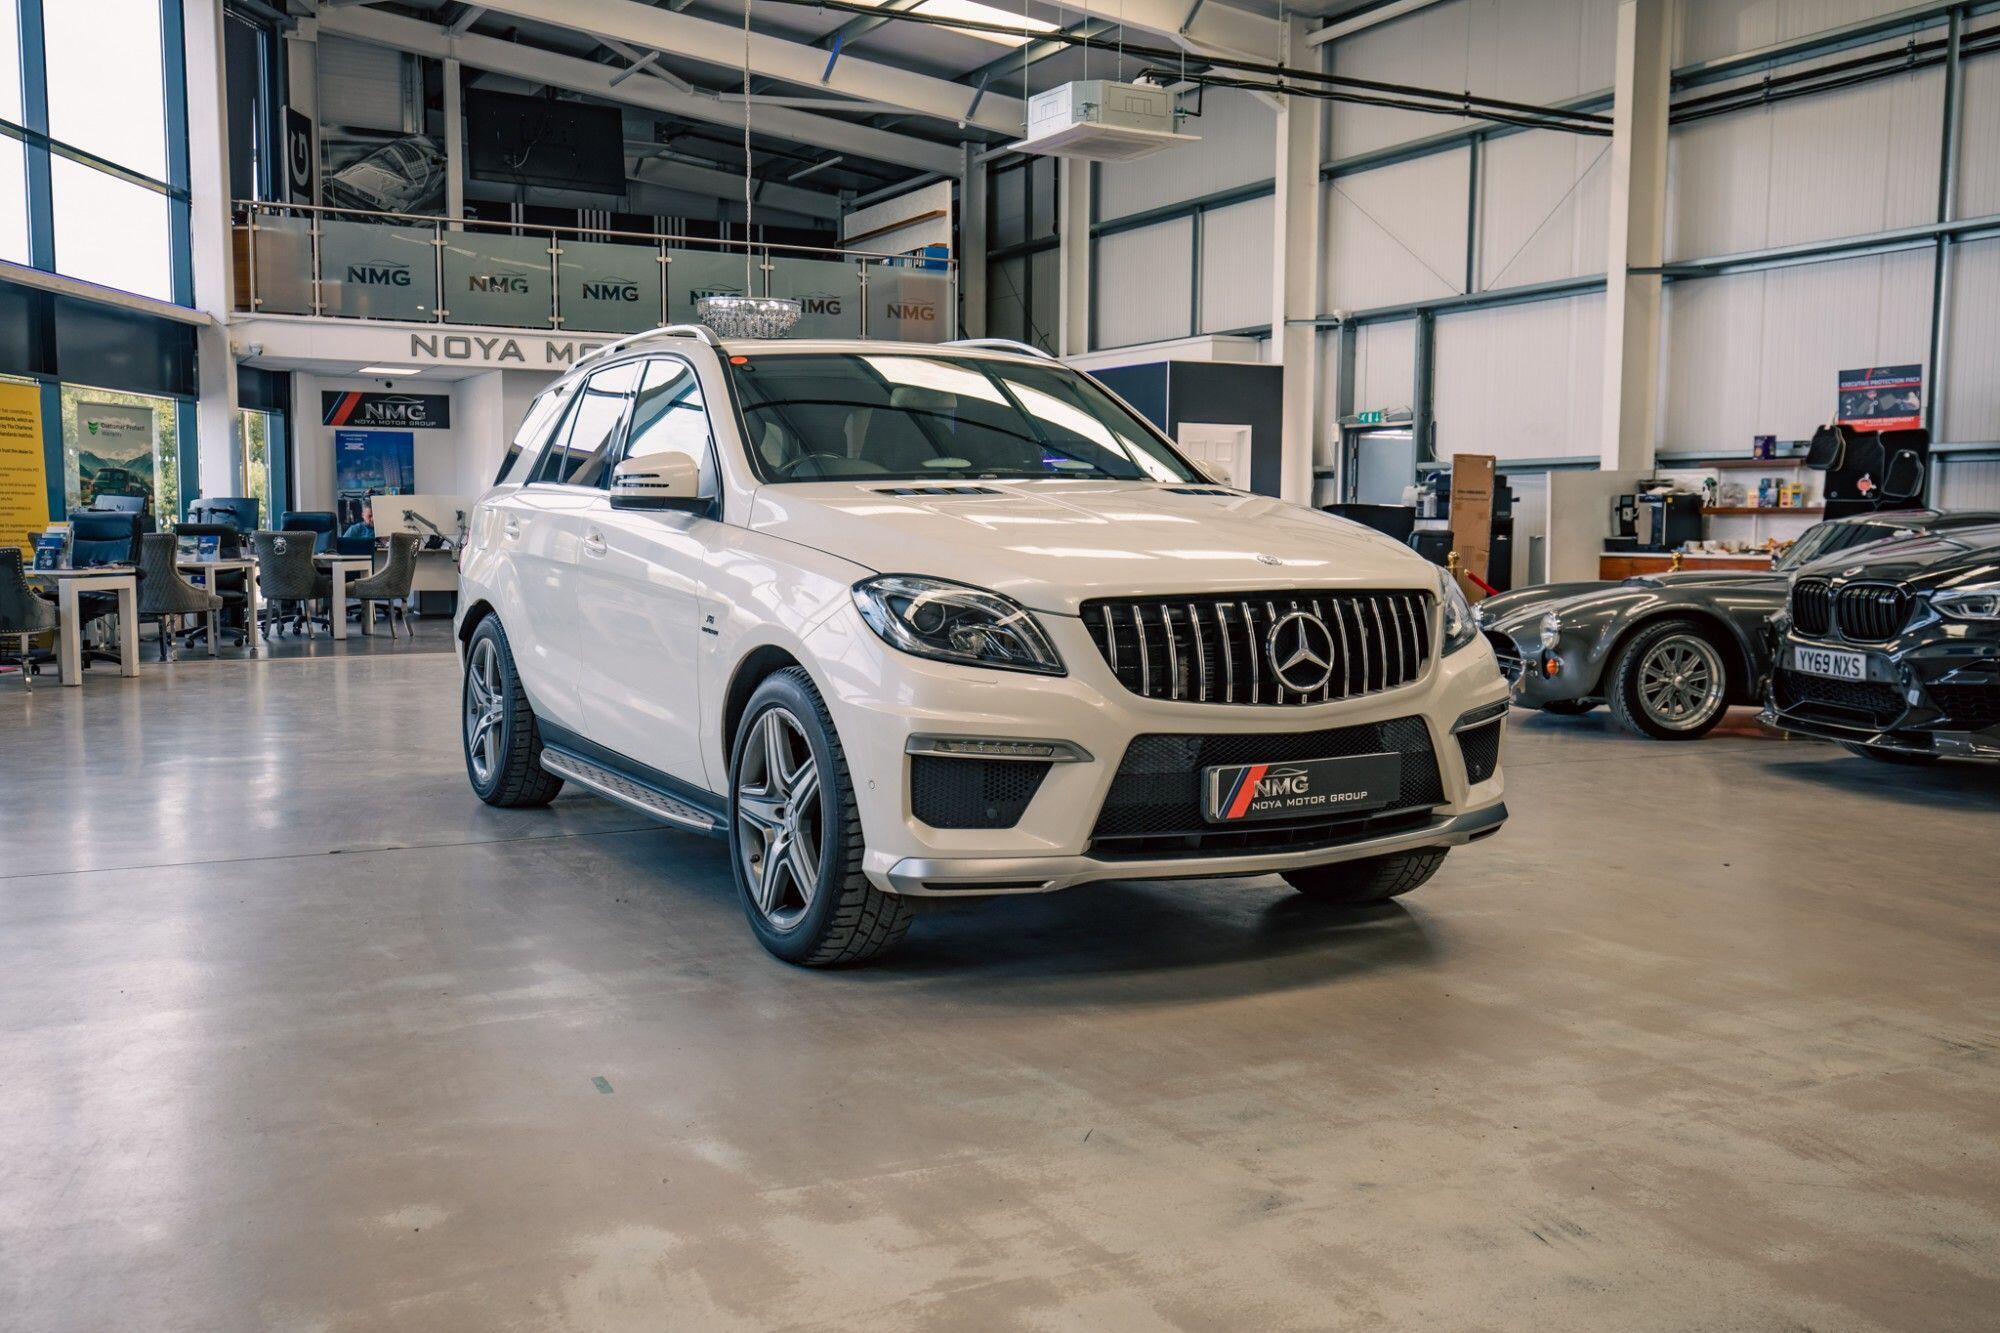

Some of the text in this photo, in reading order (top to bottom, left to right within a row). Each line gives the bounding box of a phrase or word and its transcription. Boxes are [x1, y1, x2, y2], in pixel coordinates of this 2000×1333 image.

[347, 266, 411, 287] NMG
[468, 275, 529, 294] NMG
[582, 283, 640, 301] NMG
[887, 303, 935, 321] NMG
[411, 333, 526, 362] NOYA
[364, 402, 426, 421] NMG
[1800, 650, 1861, 677] YY69 NXS
[1254, 776, 1309, 798] NMG
[1252, 791, 1368, 811] NOYA MOTOR GROUP
